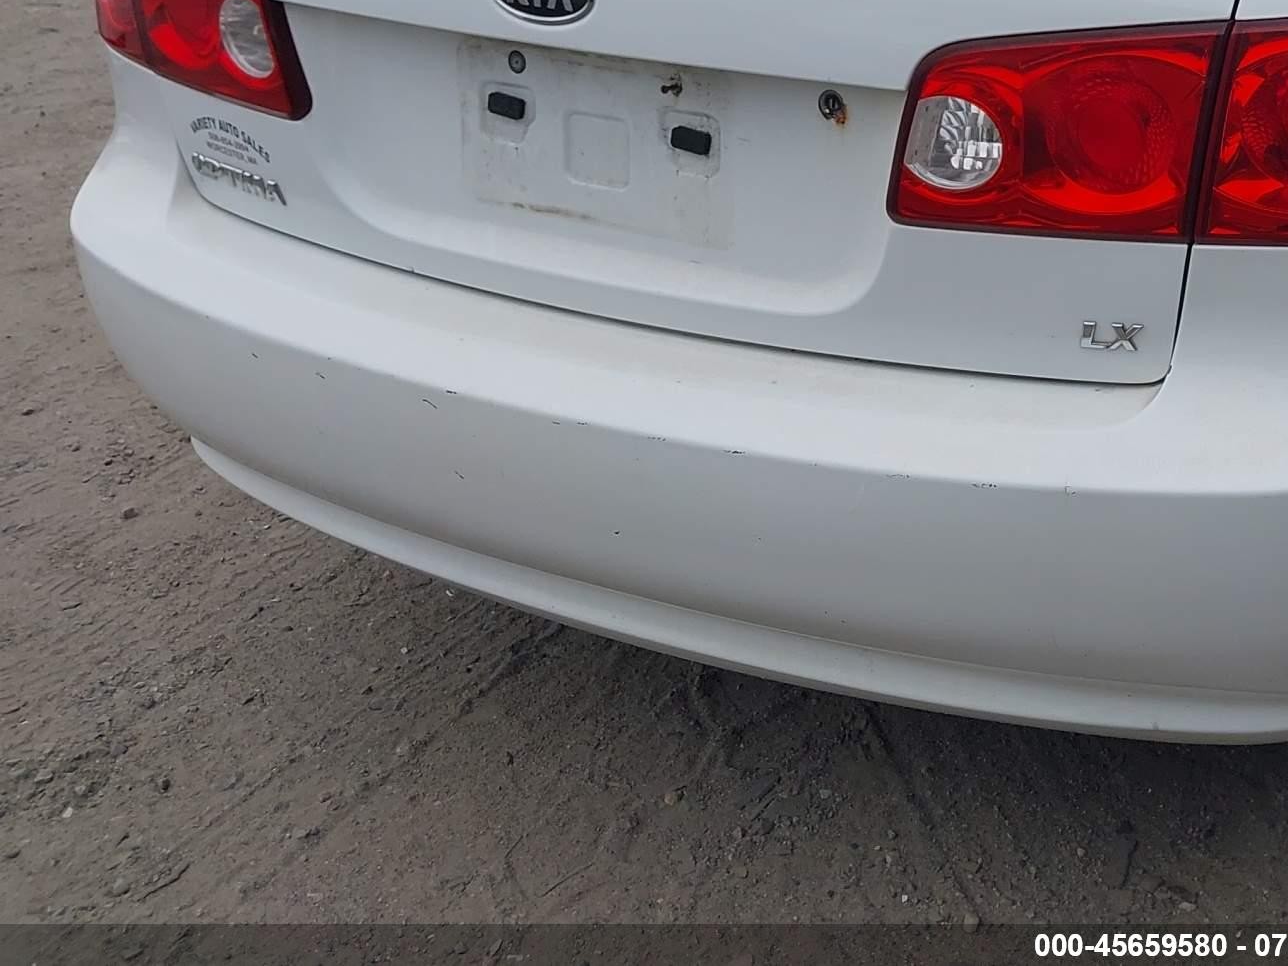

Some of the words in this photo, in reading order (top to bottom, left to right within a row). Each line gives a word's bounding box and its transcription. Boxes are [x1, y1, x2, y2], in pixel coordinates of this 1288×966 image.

[190, 116, 217, 134] VARIETY
[218, 119, 239, 139] AUTO
[241, 130, 271, 163] SALES
[1080, 320, 1144, 351] LX
